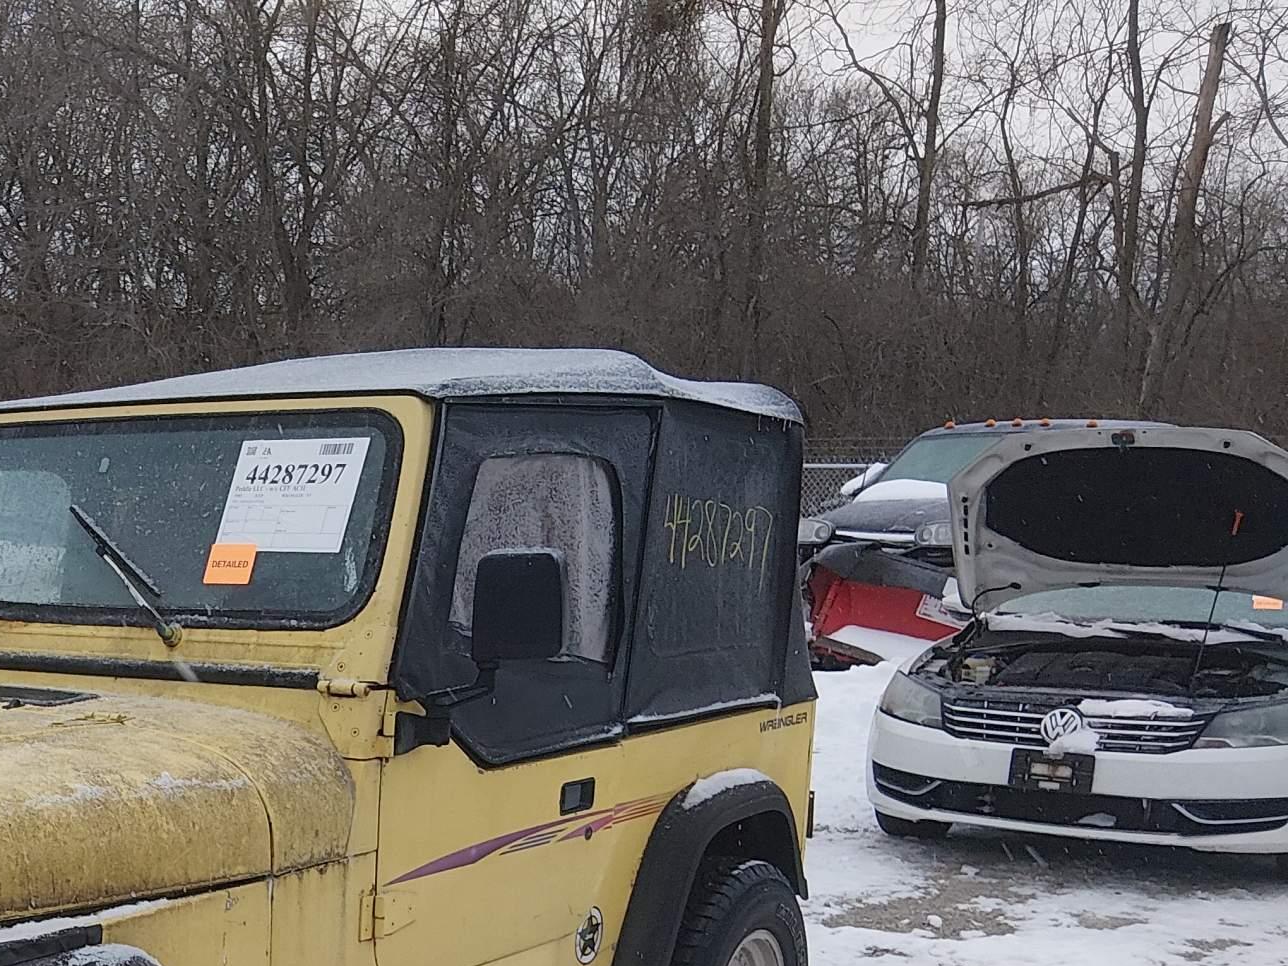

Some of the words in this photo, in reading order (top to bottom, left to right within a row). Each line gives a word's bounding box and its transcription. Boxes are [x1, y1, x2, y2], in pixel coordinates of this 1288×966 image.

[245, 463, 348, 485] 44287297
[664, 492, 773, 597] 44287297
[211, 560, 249, 569] DETAILED
